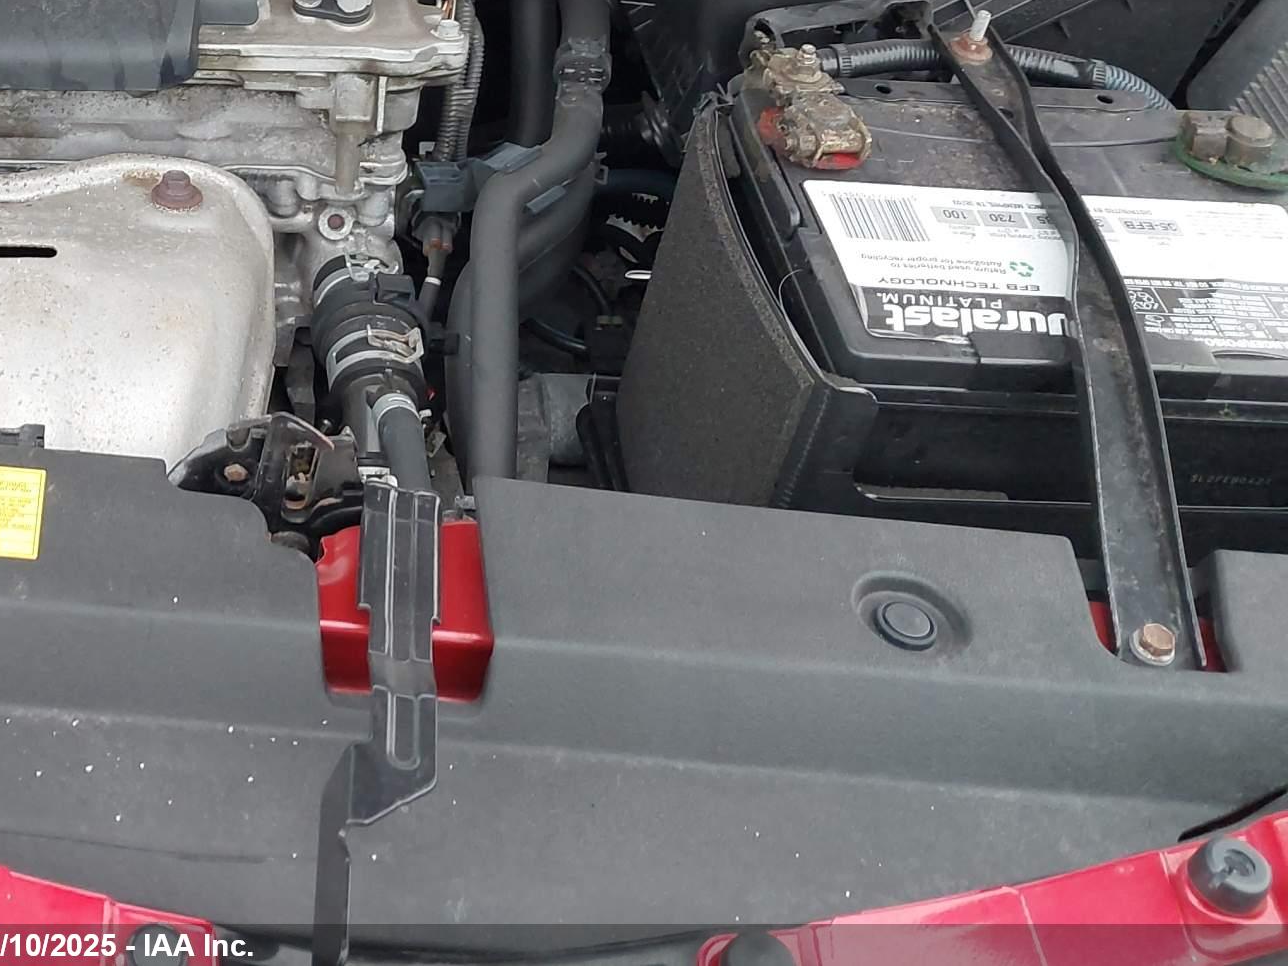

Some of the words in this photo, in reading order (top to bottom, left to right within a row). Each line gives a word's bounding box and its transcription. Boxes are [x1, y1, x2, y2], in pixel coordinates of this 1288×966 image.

[942, 209, 967, 221] 100
[989, 212, 1016, 224] 730
[1124, 220, 1178, 233] 35-EFB
[940, 258, 955, 266] for
[902, 263, 946, 272] batteries
[948, 264, 972, 273] used
[974, 266, 1007, 276] Return
[878, 276, 999, 291] TECHNOLOGY
[1006, 282, 1041, 292] EFB
